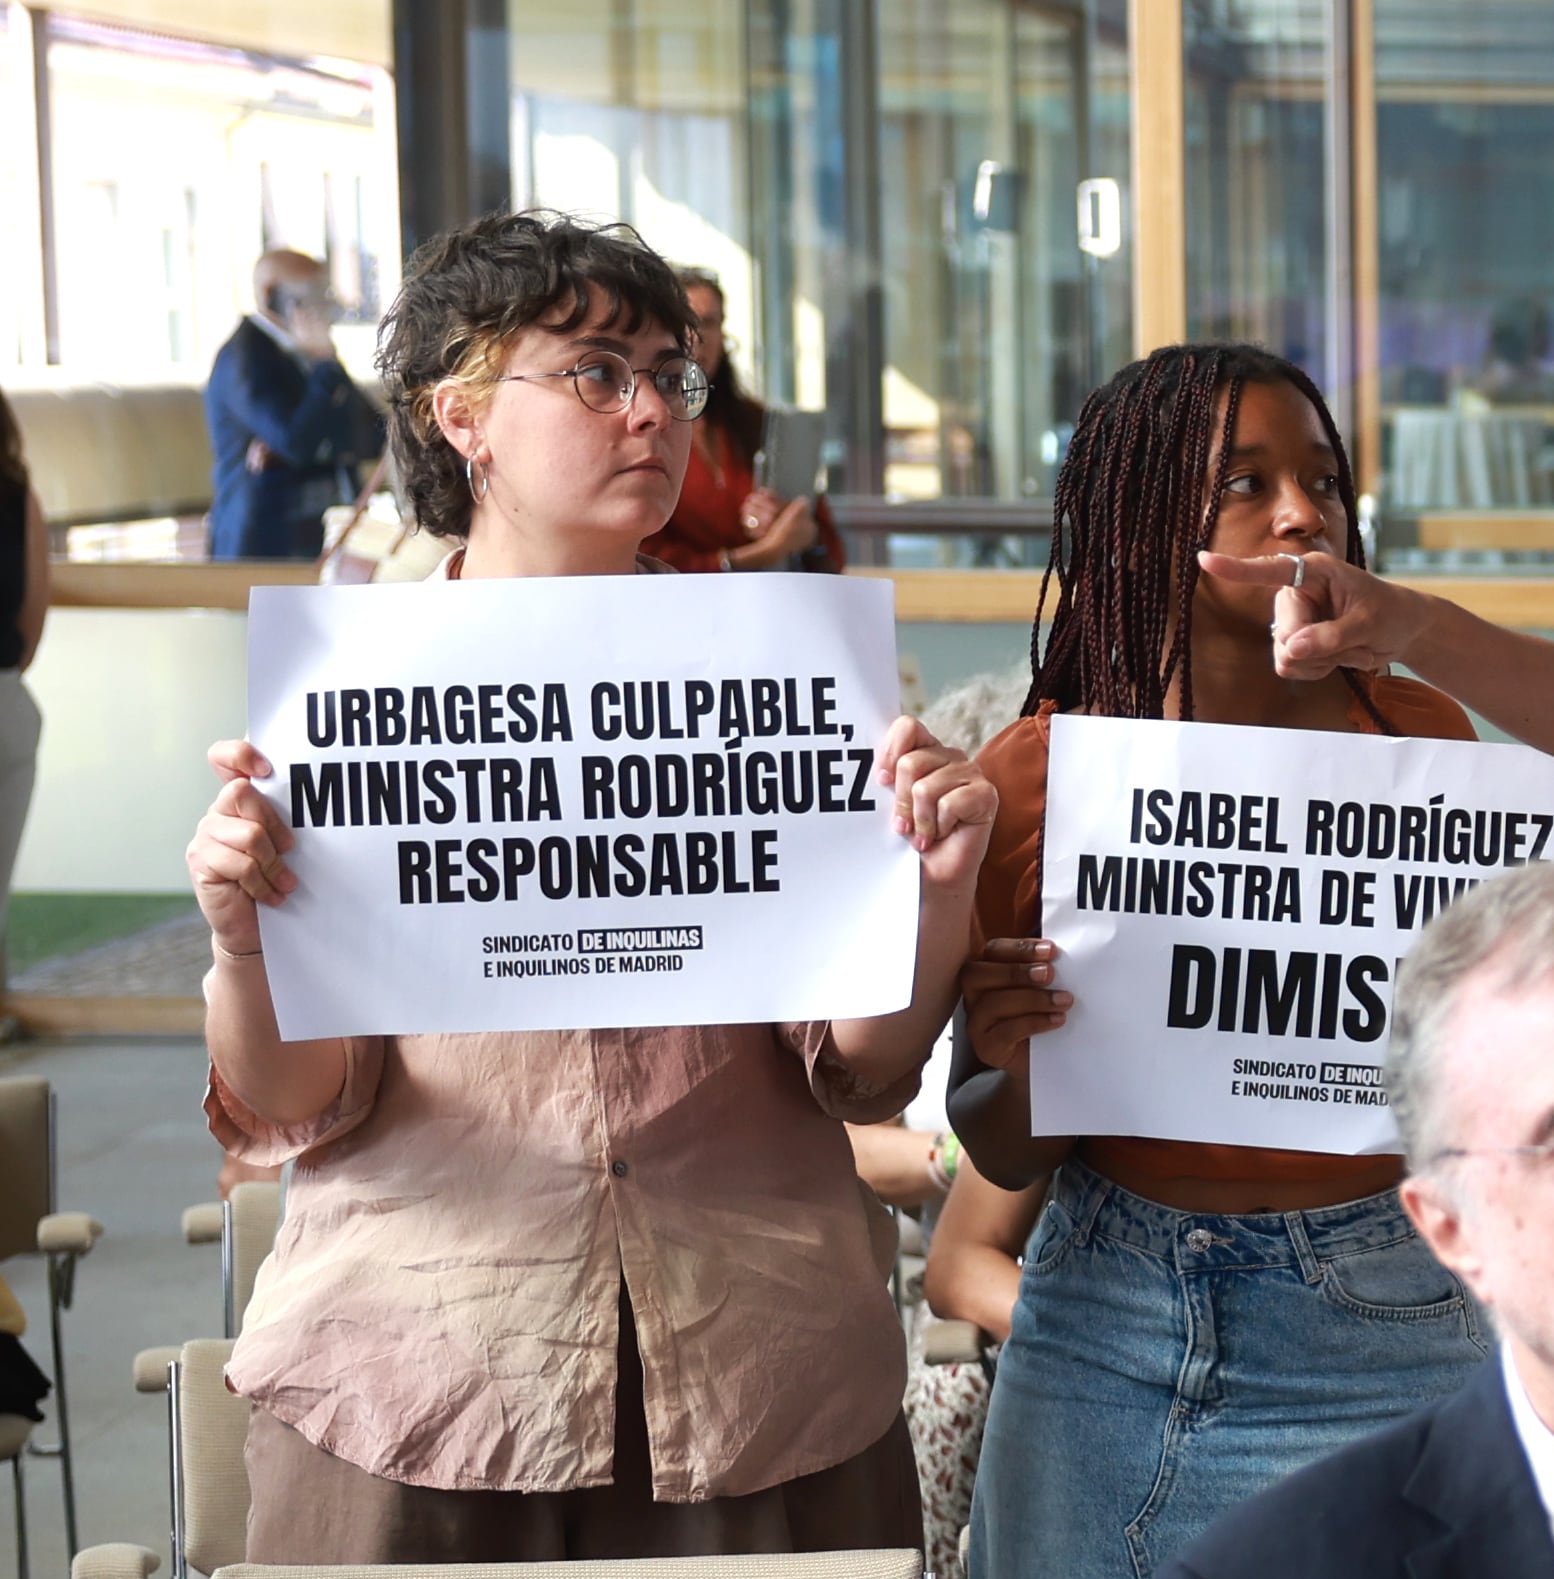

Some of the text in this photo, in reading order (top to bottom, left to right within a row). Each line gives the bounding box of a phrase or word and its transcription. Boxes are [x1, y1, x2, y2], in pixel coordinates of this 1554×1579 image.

[306, 677, 855, 747] URBAGESA CULPABLE,
[289, 735, 876, 829] MINISTRA RODRÍGUEZ
[1130, 788, 1287, 853] ISABEL
[397, 829, 779, 904] RESPONSABLE
[1076, 854, 1301, 923] MINISTRA
[1319, 869, 1376, 927] DE
[482, 929, 700, 953] SINDICATO DE INQUILINAS
[483, 954, 682, 978] E INQUILINOS DE MADRID
[1167, 944, 1396, 1042] DIMIS
[1231, 1080, 1392, 1107] E INQUILINOS DE MAD
[1232, 1058, 1384, 1086] SINDICATO DE INQU
